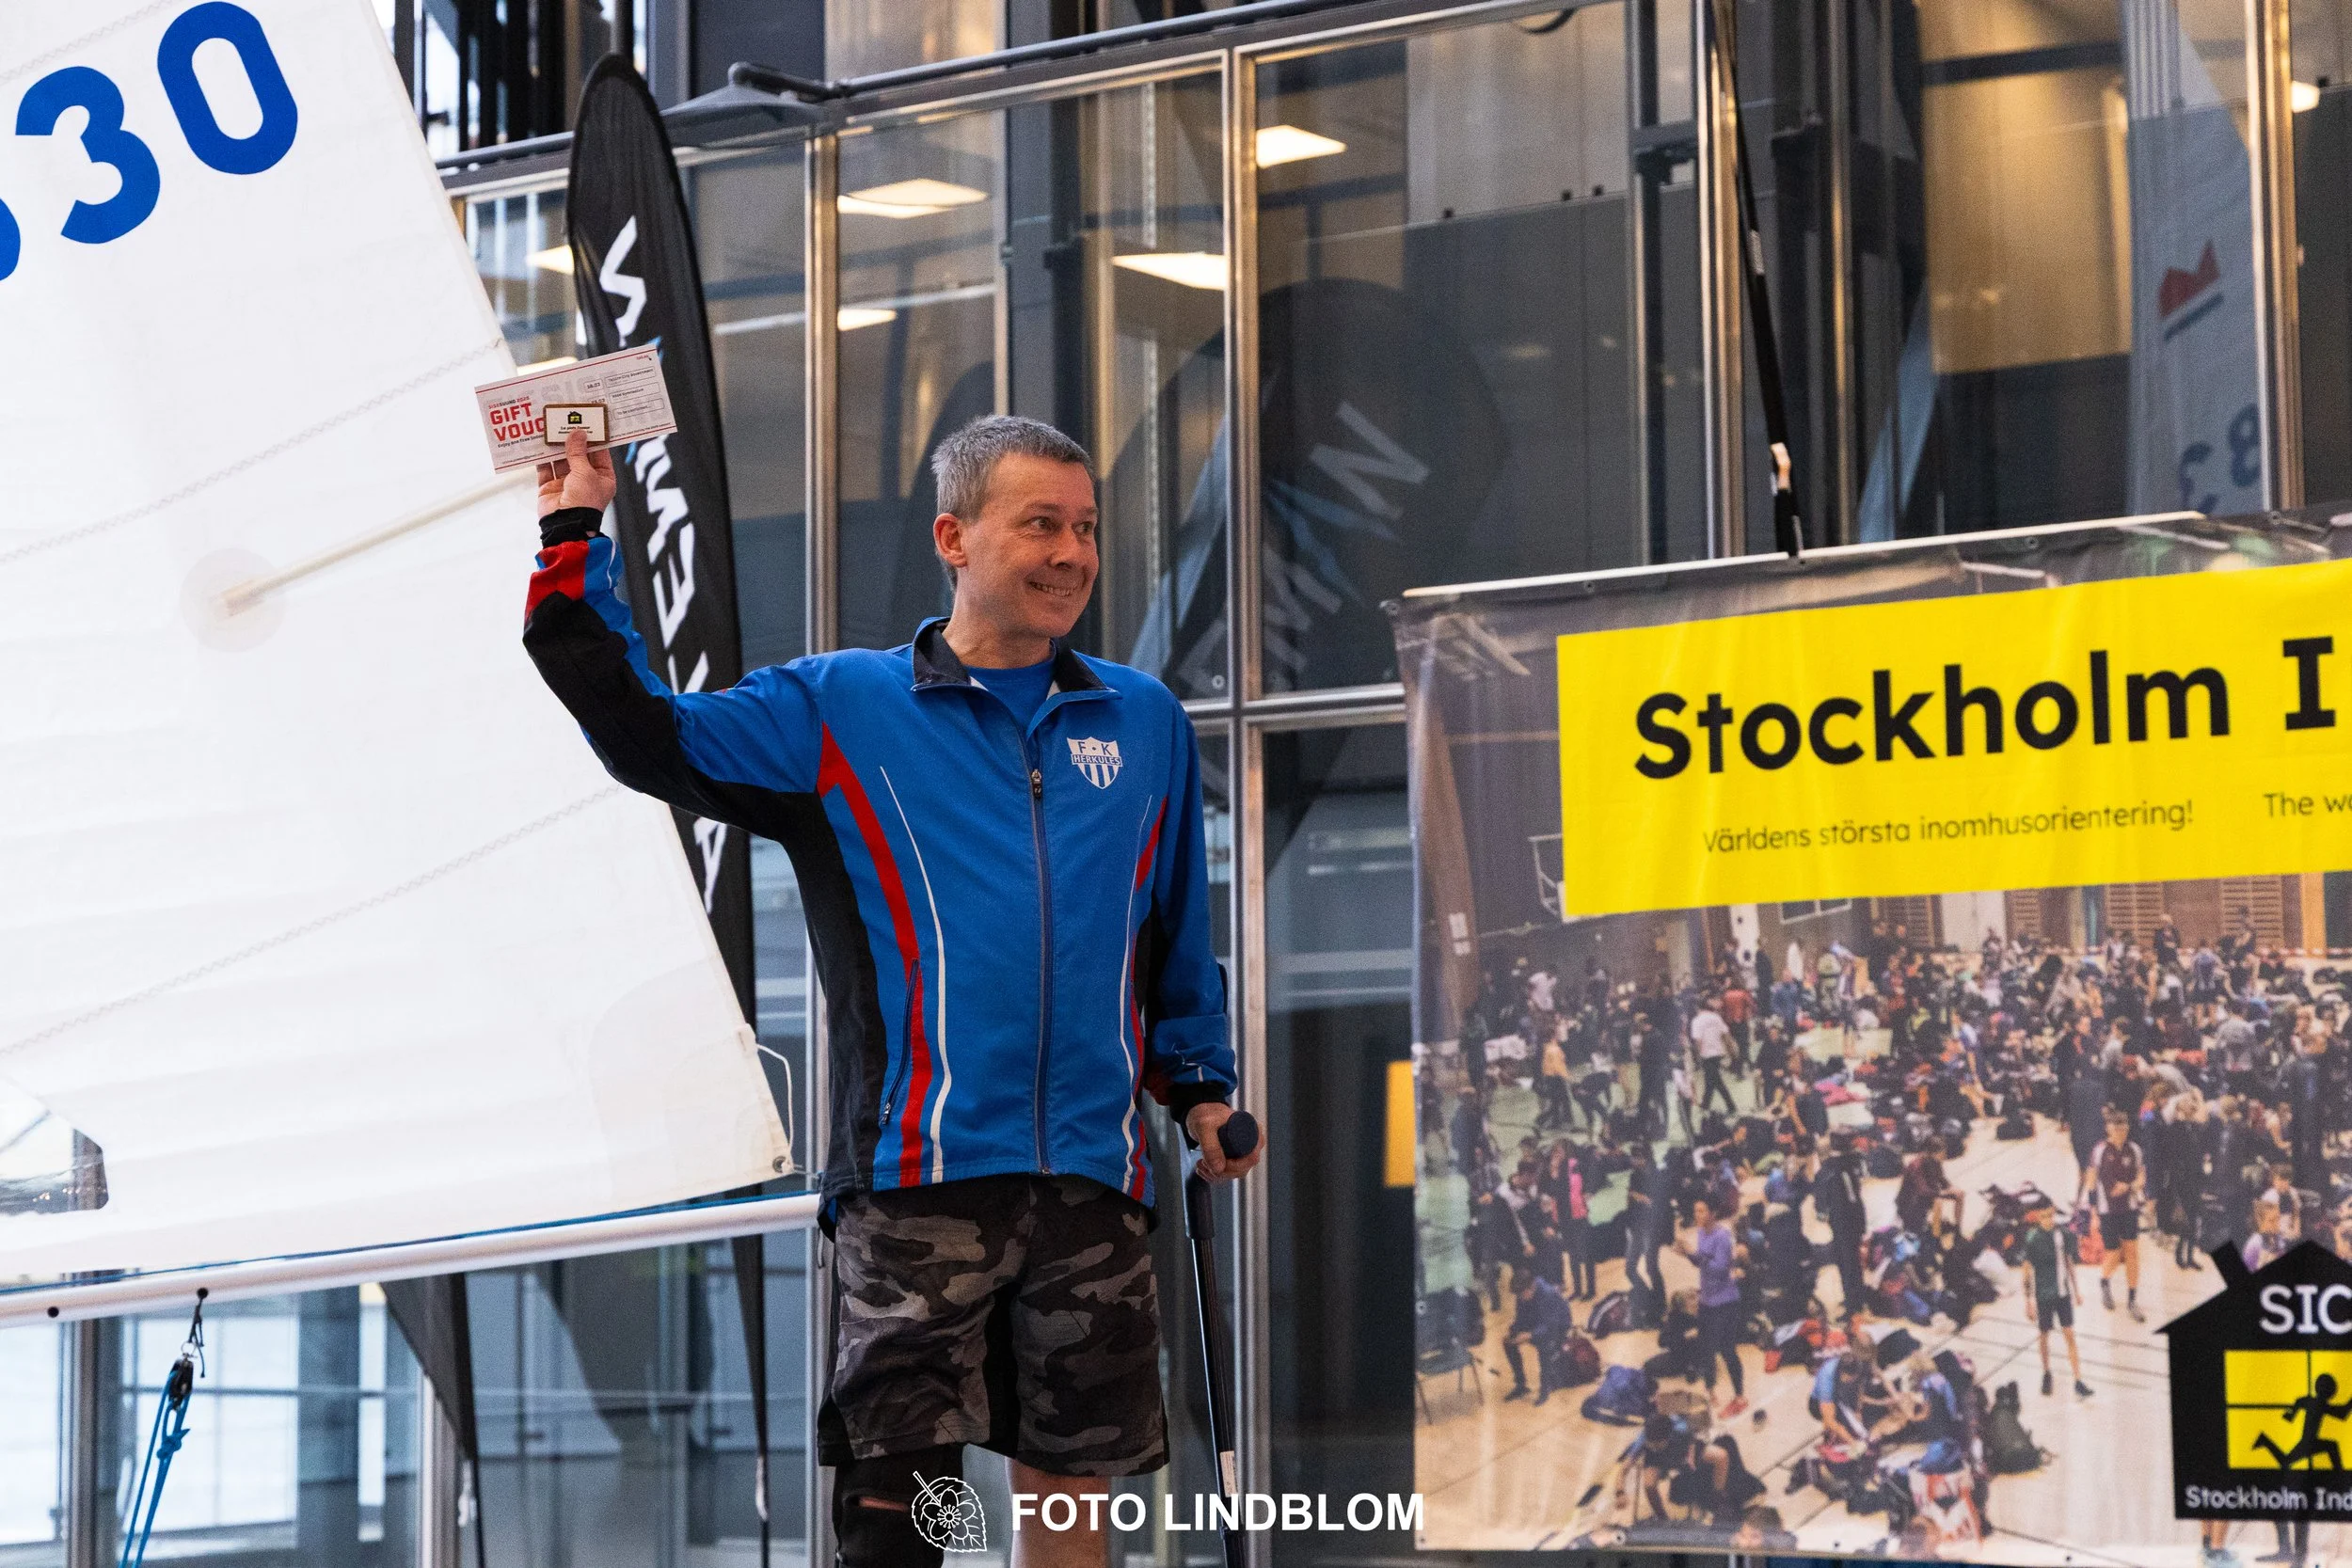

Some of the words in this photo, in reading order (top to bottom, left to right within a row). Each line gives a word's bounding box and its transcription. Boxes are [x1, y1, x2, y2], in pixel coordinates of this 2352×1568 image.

[489, 402, 532, 425] GIFT
[1634, 650, 2230, 780] Stockholm
[1073, 754, 1121, 765] HERKULES
[2263, 792, 2314, 817] The
[2323, 793, 2352, 813] w
[1703, 825, 1811, 853] Världens
[1819, 818, 1911, 846] största
[1919, 800, 2193, 840] inomhusorientering!
[2185, 1485, 2308, 1510] Stockholm
